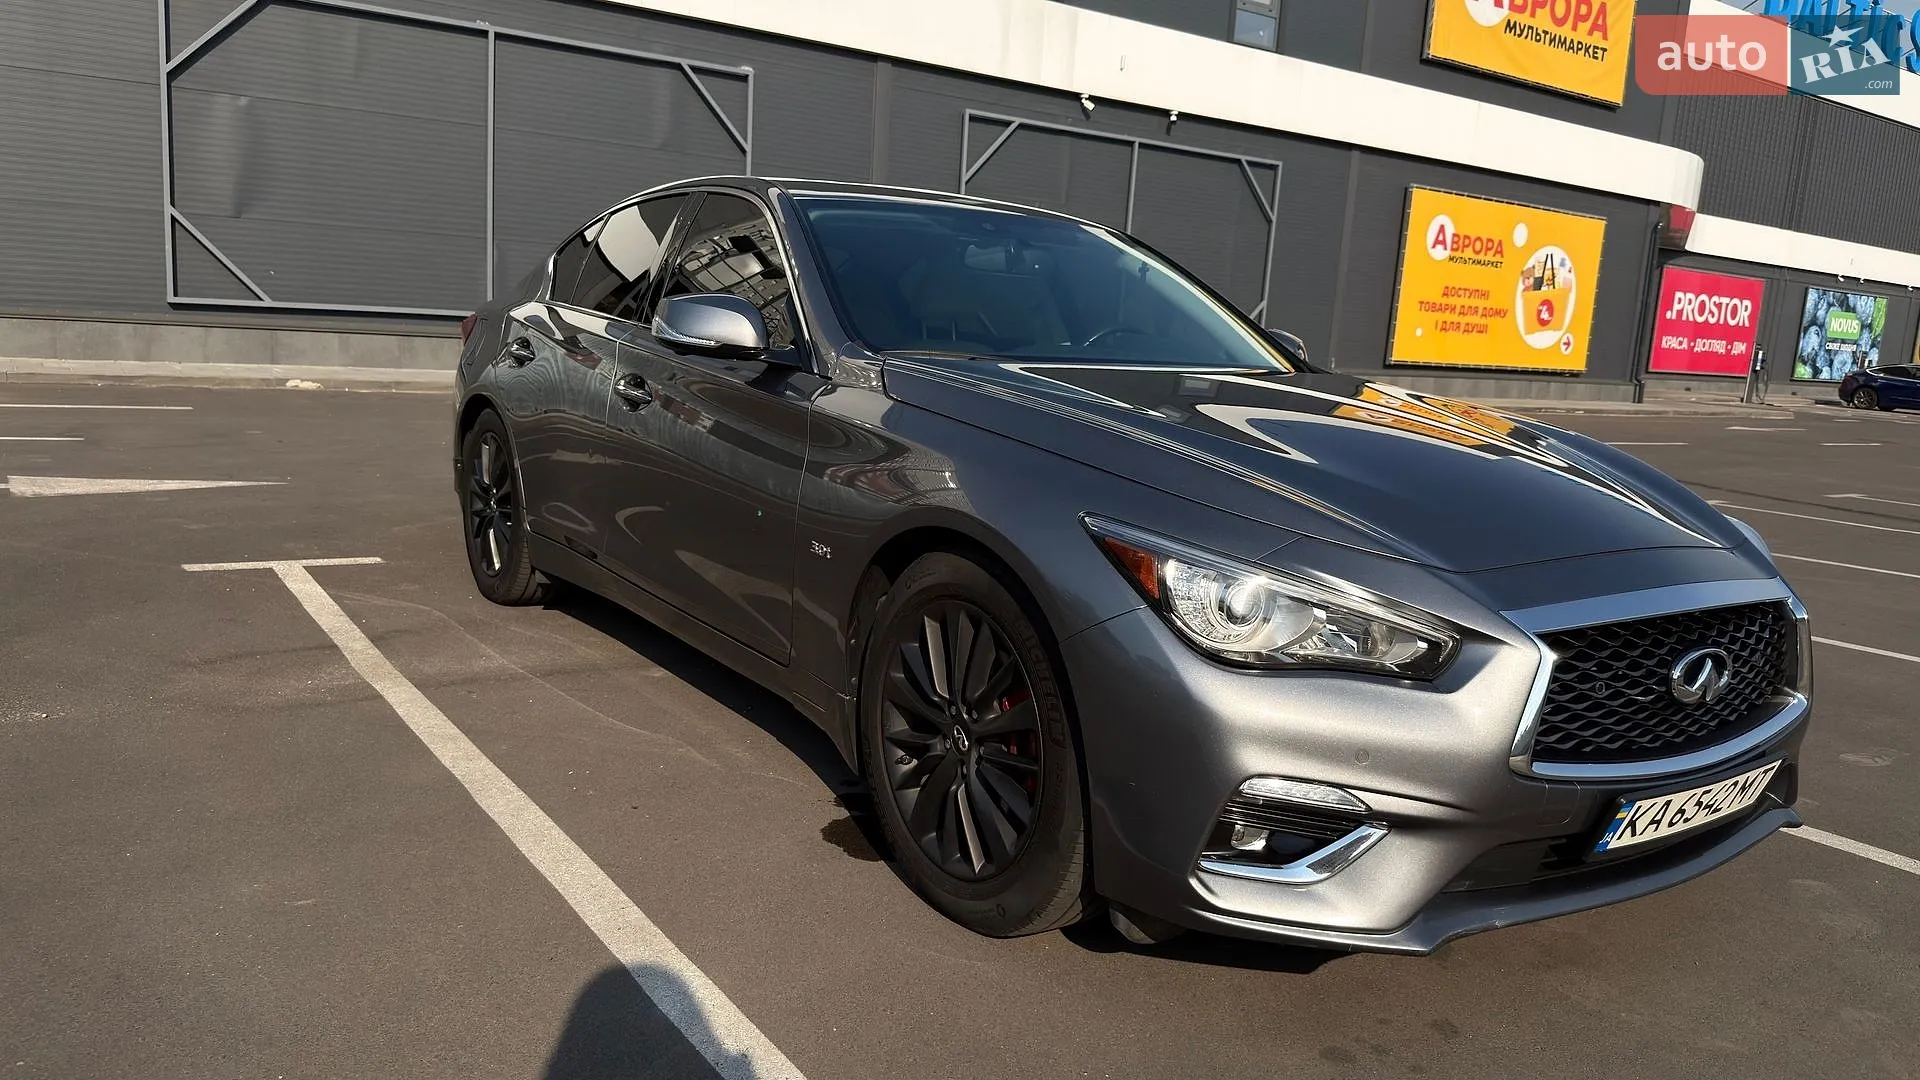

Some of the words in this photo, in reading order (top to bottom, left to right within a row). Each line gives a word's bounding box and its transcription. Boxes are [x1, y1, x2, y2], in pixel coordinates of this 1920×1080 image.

[1473, 0, 1608, 41] РОРА
[1504, 18, 1608, 62] МУЛЬТИМАРКЕТ
[1431, 224, 1504, 258] АВРОРА
[1448, 256, 1503, 269] МУЛЬТИМАРКЕТ
[1442, 286, 1490, 300] ДОСТУПНІ
[1418, 301, 1456, 315] ТОВАРИ
[1459, 305, 1479, 317] ДЛЯ
[1481, 307, 1508, 319] ДОМУ
[1440, 321, 1461, 332] ДЛЯ
[1464, 322, 1488, 334] ДУШІ
[1831, 317, 1859, 334] NOVUS
[1661, 336, 1688, 350] КРАСА
[1694, 338, 1726, 354] ДОГЛЯД
